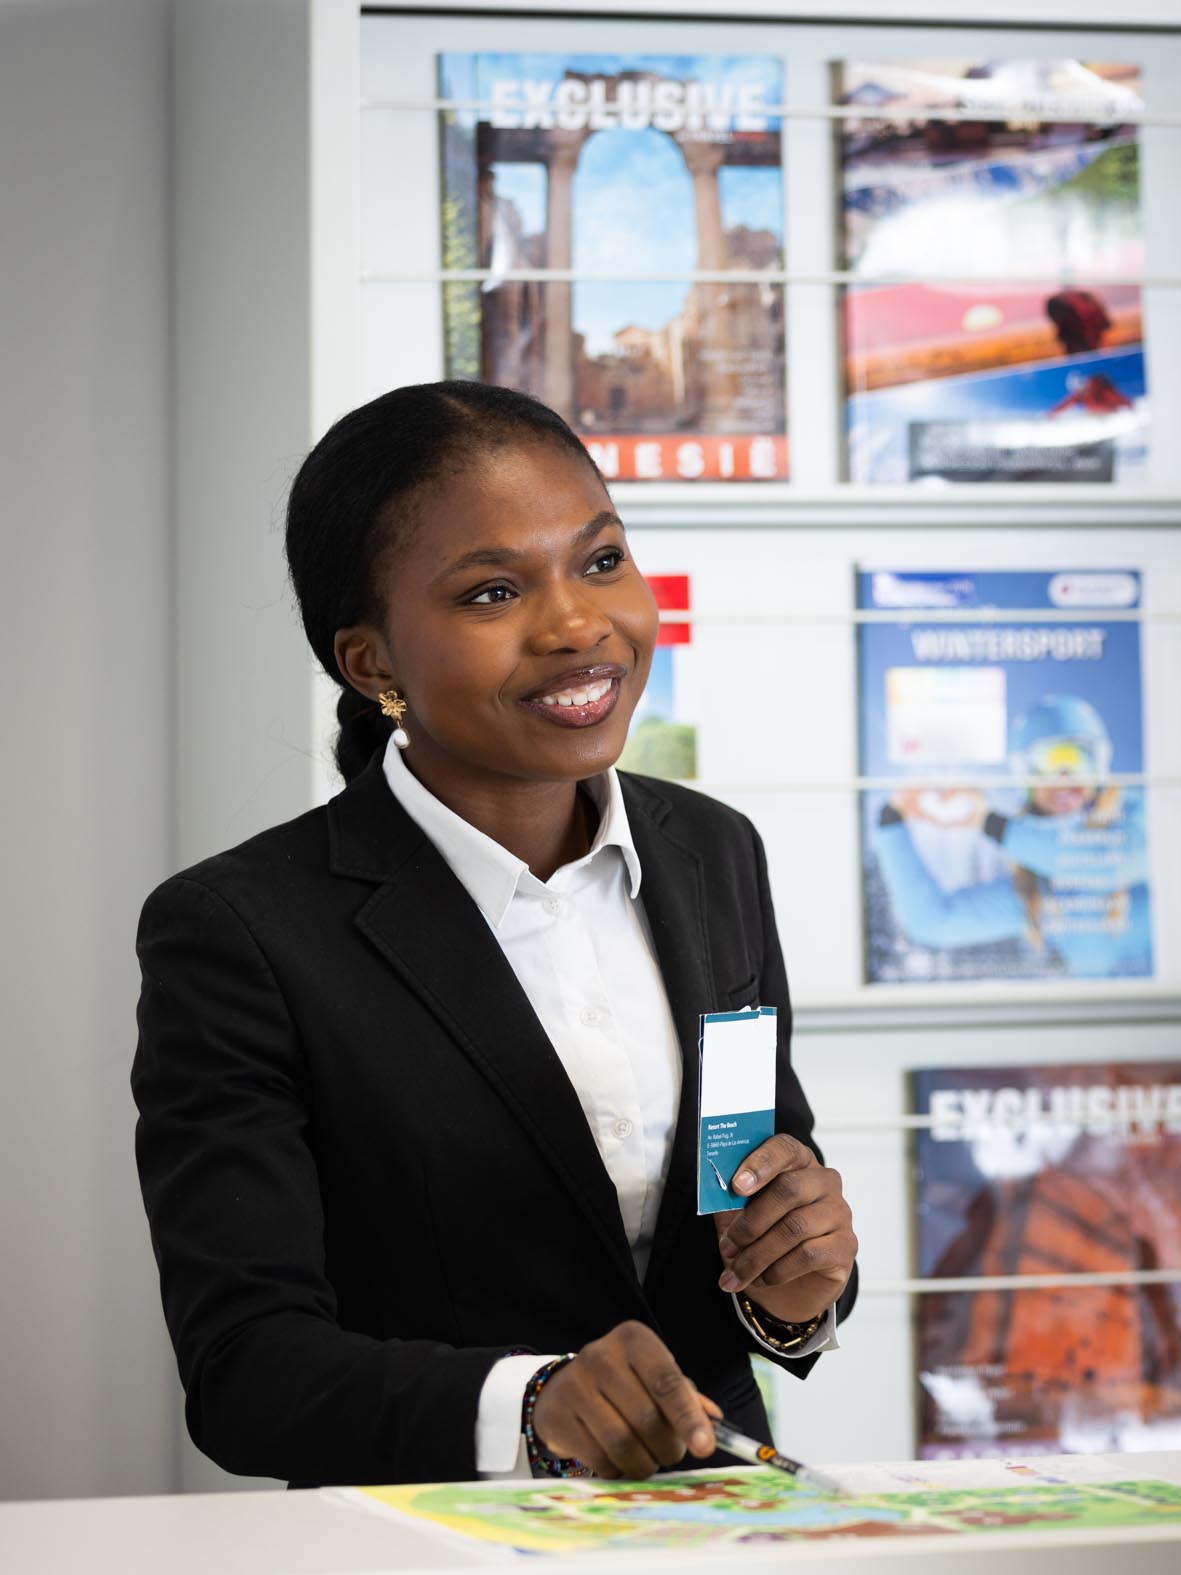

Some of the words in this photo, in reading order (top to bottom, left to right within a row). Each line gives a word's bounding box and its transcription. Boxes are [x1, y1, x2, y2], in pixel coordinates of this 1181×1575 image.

[491, 79, 768, 131] EXCLUSIVE
[587, 435, 778, 478] NESIË
[911, 627, 1106, 662] WINTERSPORT
